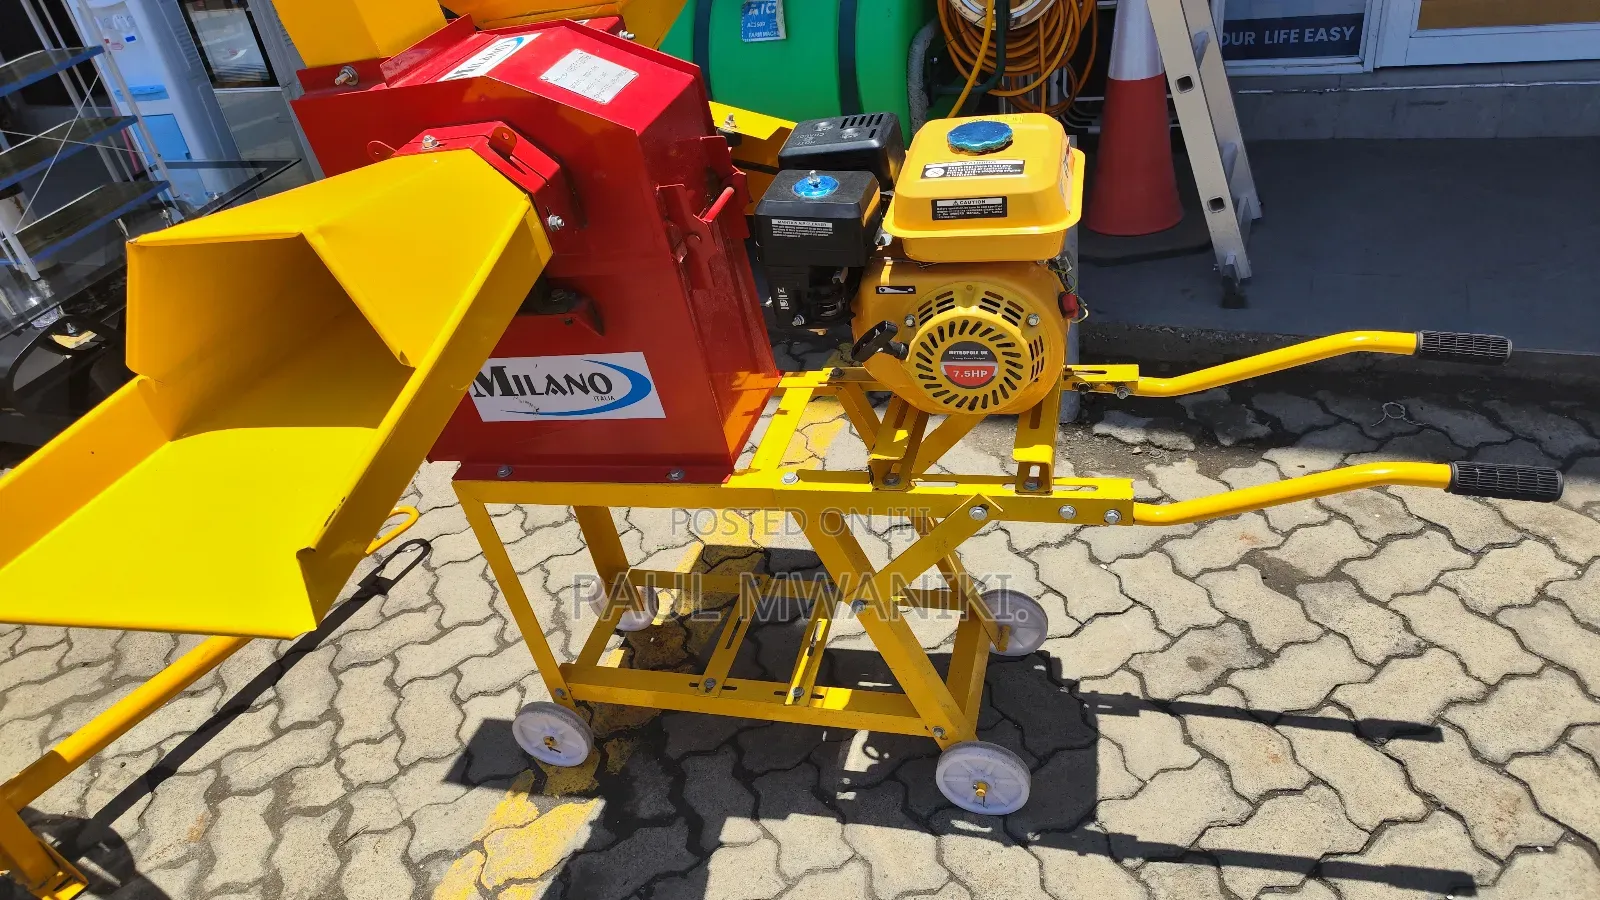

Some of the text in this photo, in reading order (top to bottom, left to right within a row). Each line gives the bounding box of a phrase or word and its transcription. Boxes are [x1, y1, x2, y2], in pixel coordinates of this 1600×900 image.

[1264, 28, 1300, 45] LIFE
[1303, 25, 1356, 43] EASY
[472, 365, 613, 398] MILANO
[953, 370, 988, 378] 7.5HP
